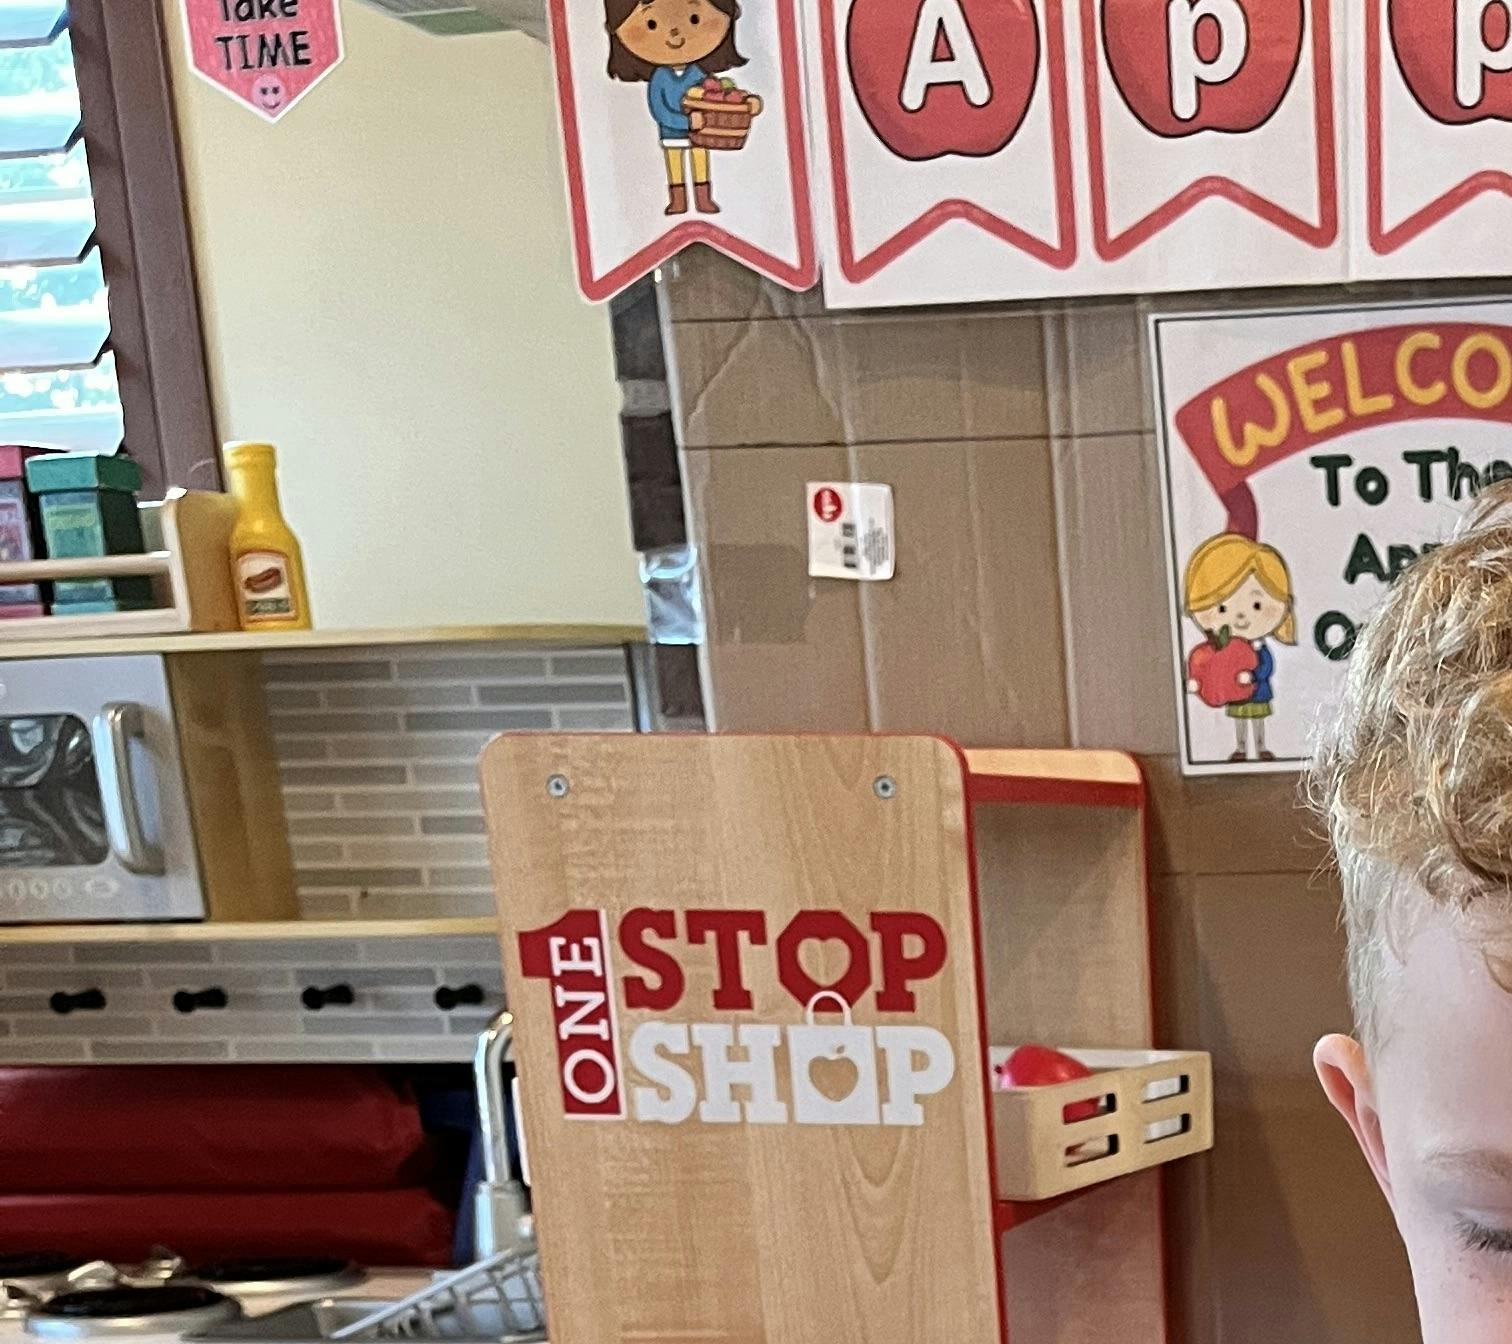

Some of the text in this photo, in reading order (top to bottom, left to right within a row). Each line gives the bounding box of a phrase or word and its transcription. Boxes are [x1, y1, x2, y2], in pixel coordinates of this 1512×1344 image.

[214, 29, 313, 71] TIME
[1310, 453, 1389, 507] To
[618, 907, 948, 1013] STOP
[549, 935, 617, 1104] ONE
[629, 1015, 956, 1126] SHOP
